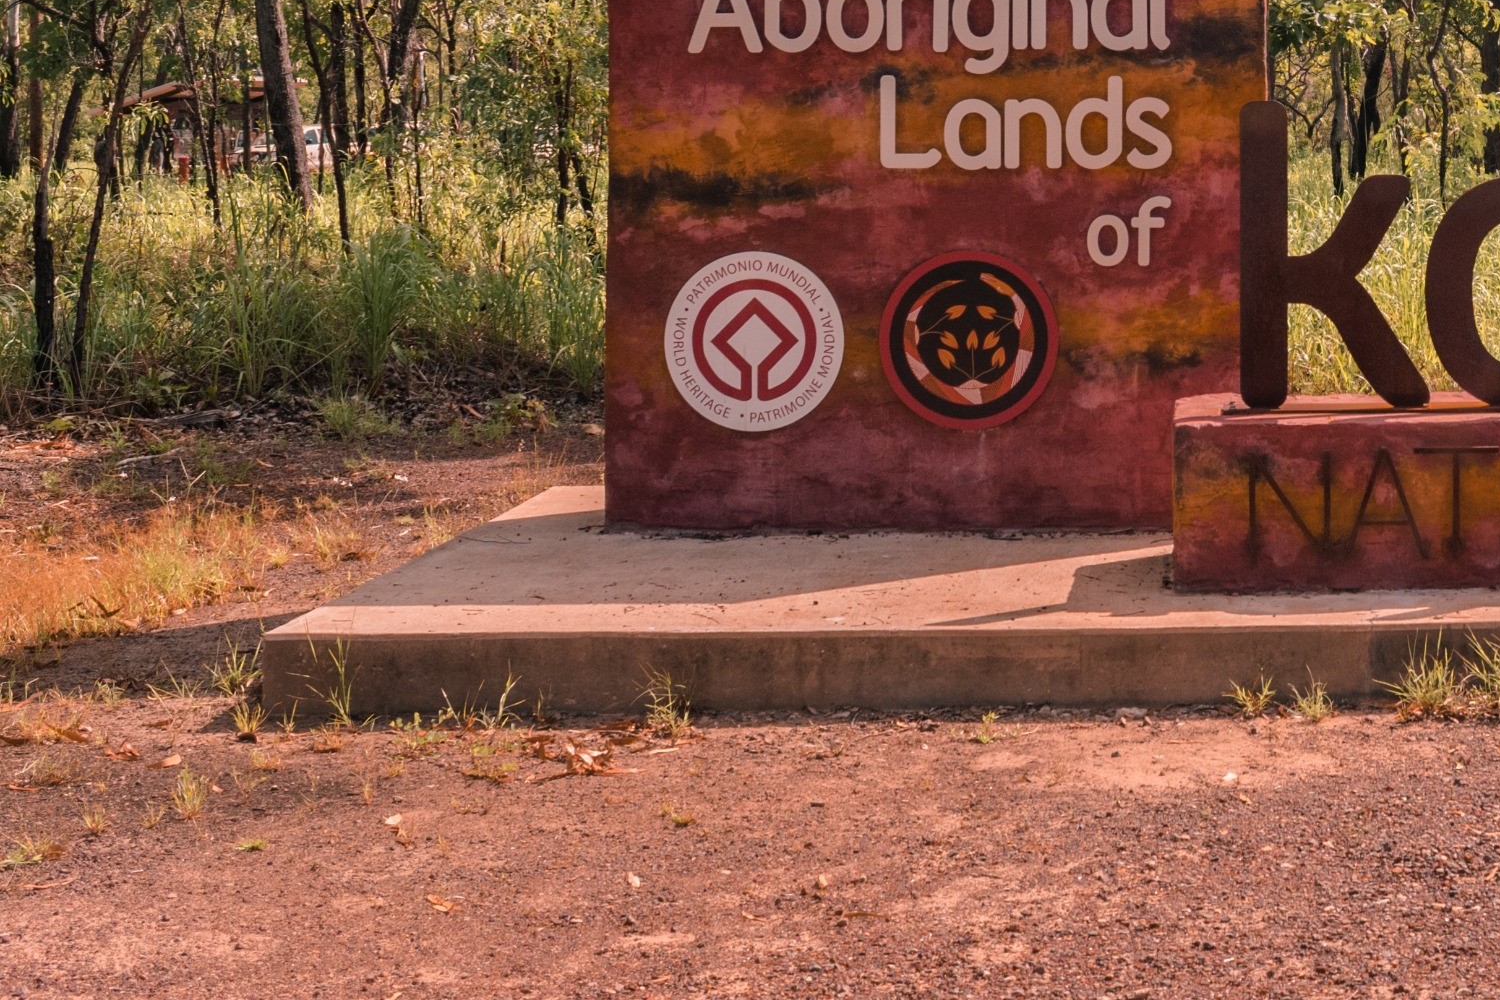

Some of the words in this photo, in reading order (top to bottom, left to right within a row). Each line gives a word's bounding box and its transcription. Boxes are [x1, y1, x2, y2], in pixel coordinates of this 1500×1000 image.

[879, 74, 1172, 170] Lands
[1086, 196, 1171, 267] of
[686, 259, 763, 304] PATRIMONIO
[766, 261, 823, 305] MUNDIAL
[673, 316, 688, 367] WORLD
[749, 378, 822, 423] PATRIMOINE
[818, 311, 836, 379] MONDIAL
[680, 369, 731, 419] HERITAGE
